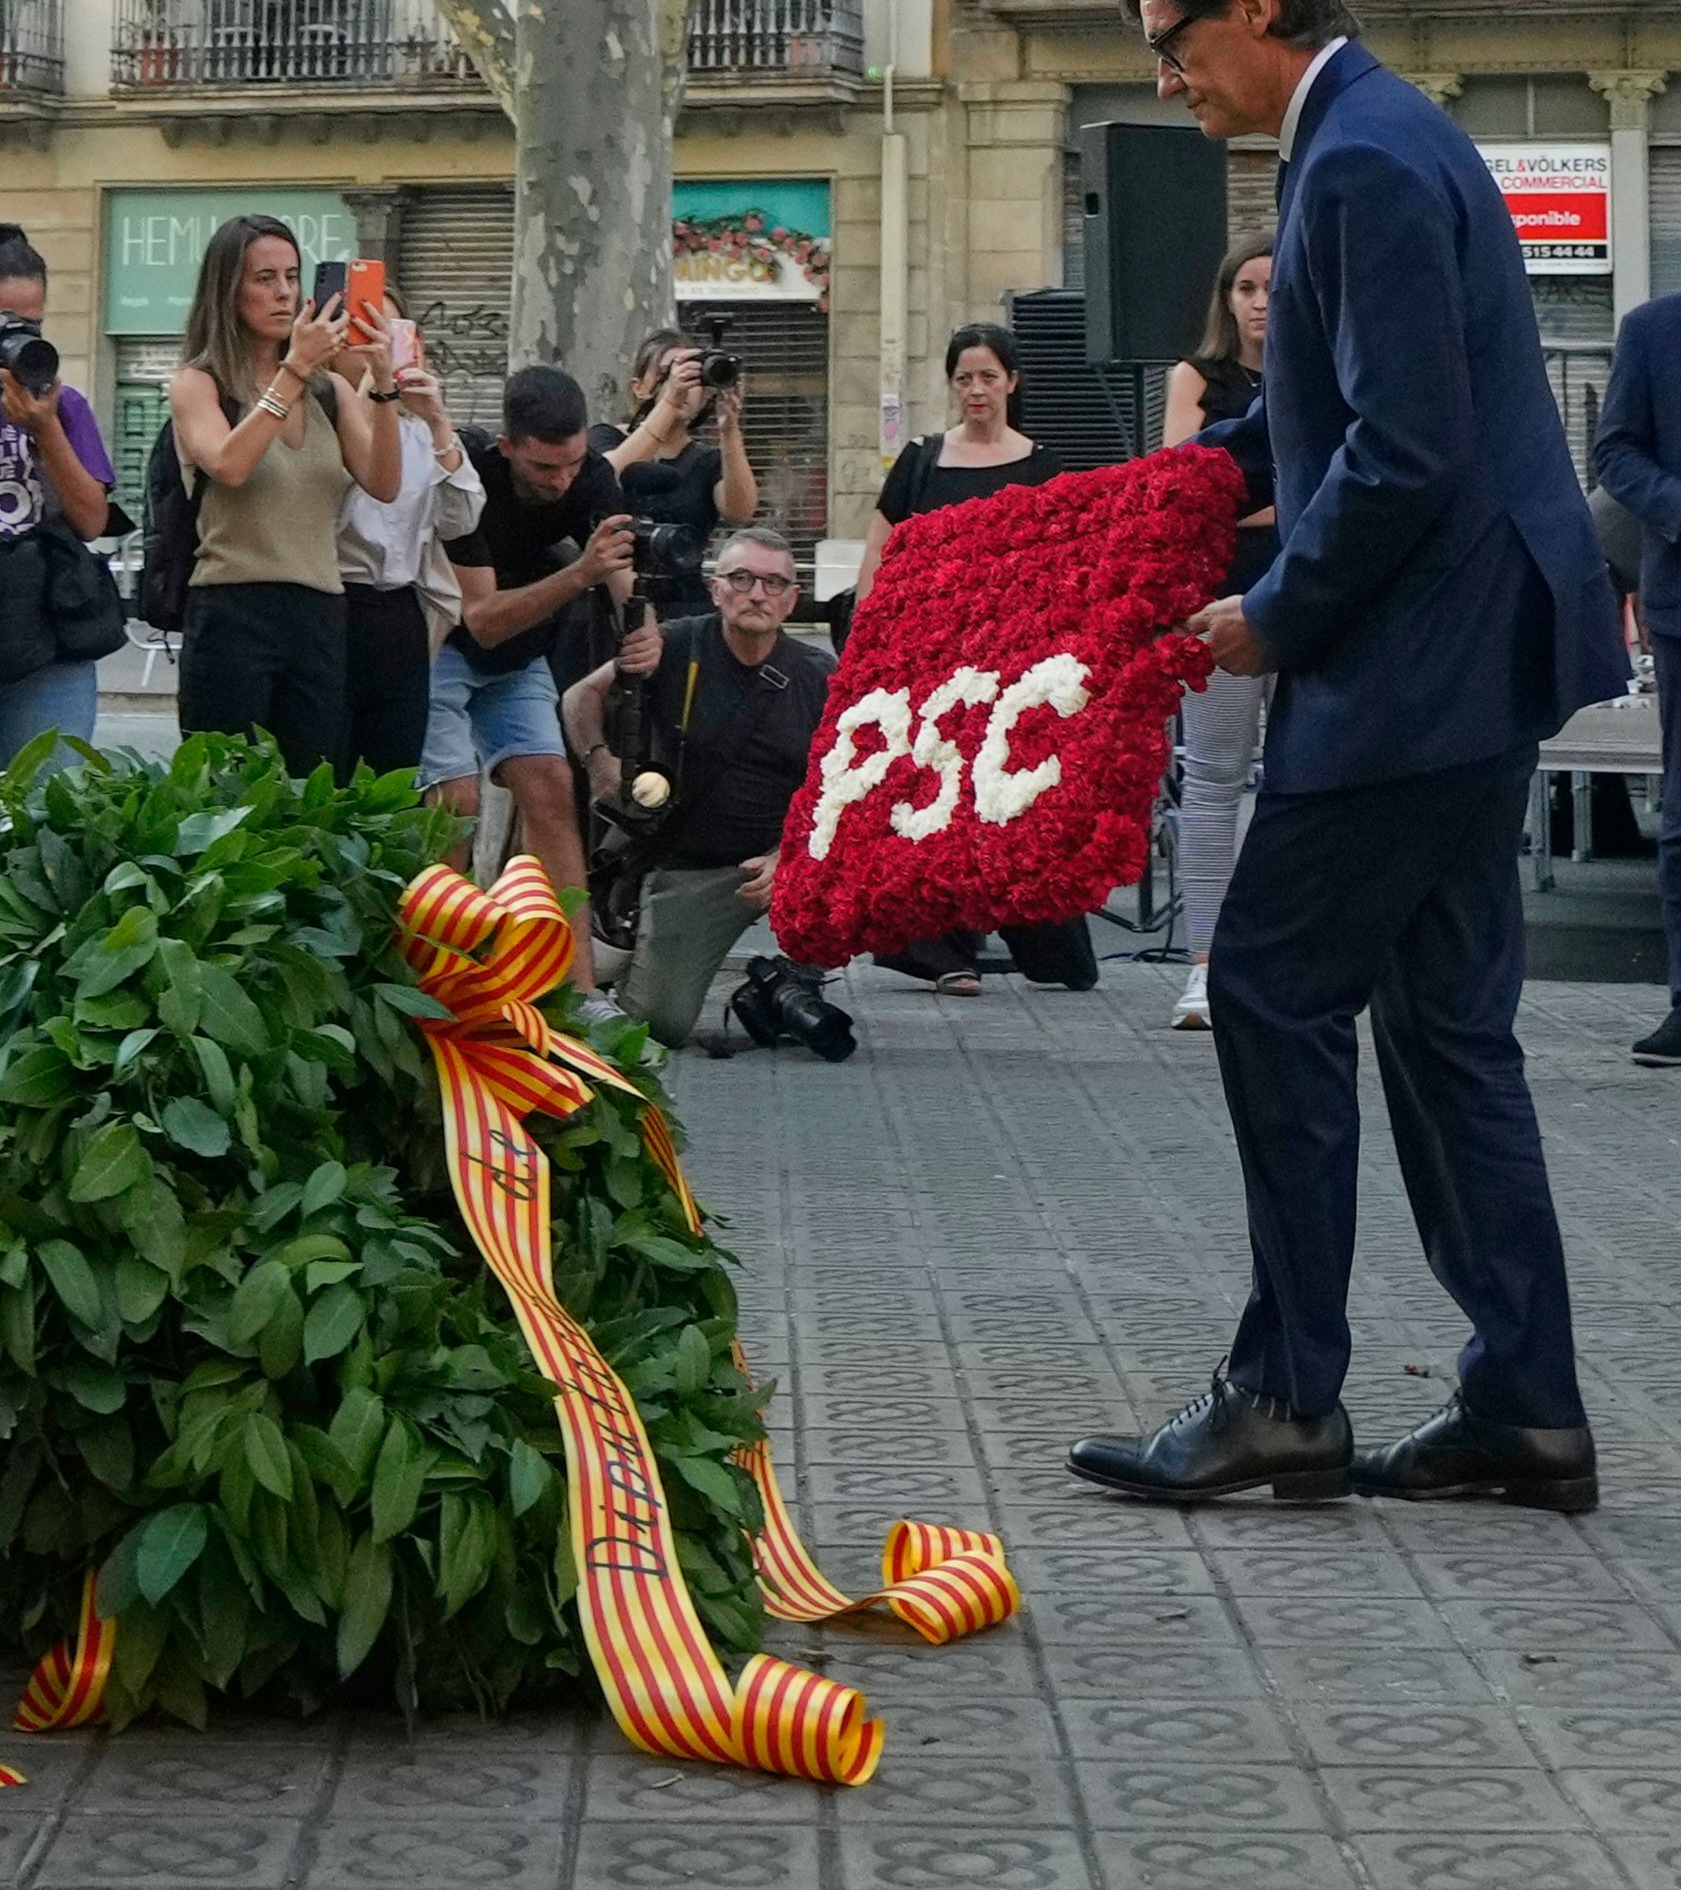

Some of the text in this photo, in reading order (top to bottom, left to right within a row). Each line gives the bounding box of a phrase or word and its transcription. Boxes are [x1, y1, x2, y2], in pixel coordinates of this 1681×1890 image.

[1485, 155, 1607, 173] GEL&VÖLKERS
[1501, 176, 1608, 189] COMMERCIAL
[1511, 211, 1581, 227] ponible
[809, 653, 1092, 860] PSC
[461, 1129, 538, 1201] de
